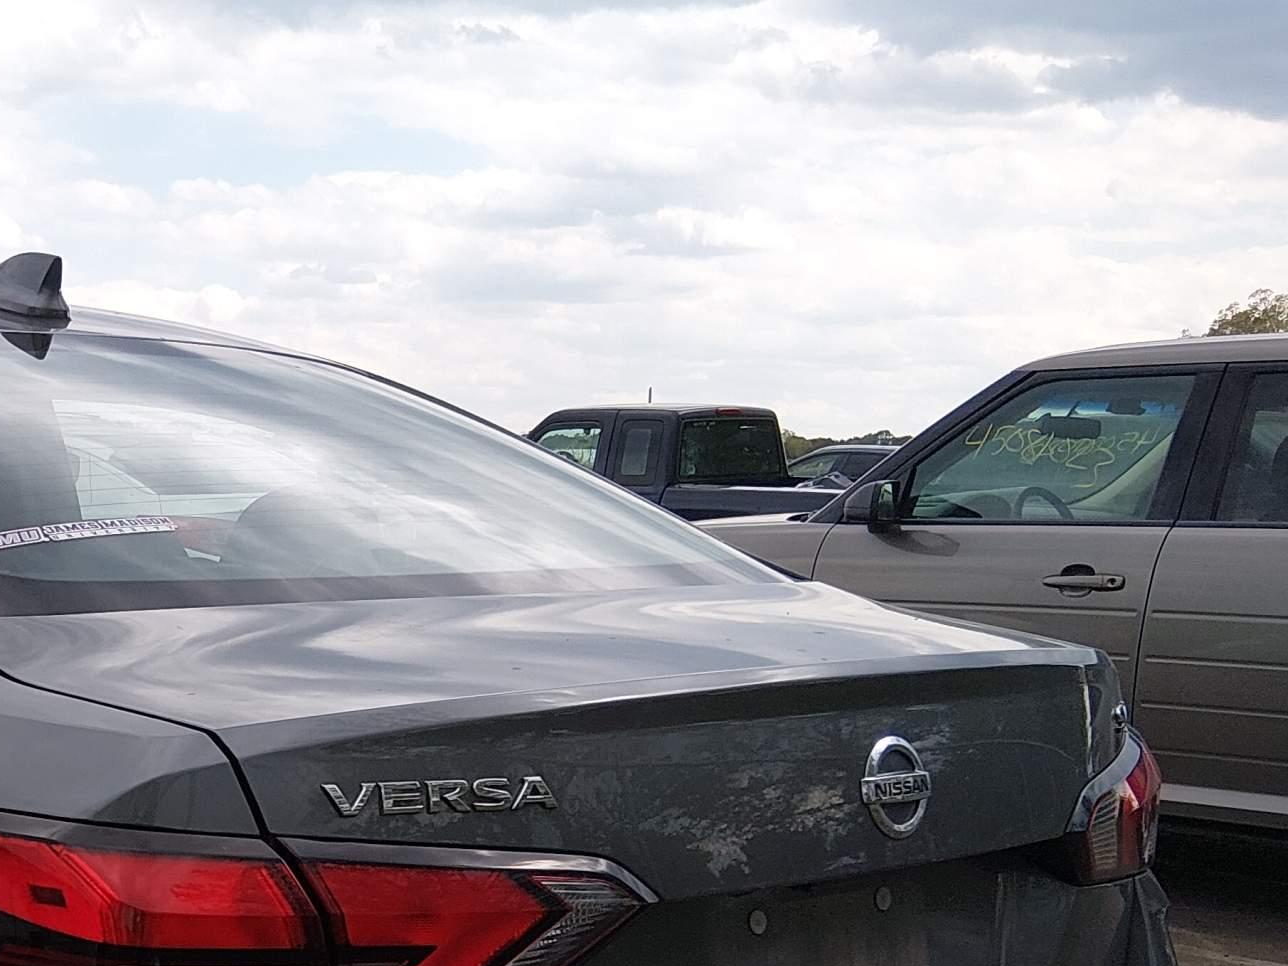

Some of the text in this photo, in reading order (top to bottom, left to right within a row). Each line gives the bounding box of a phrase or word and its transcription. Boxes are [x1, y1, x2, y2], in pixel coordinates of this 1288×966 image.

[46, 517, 171, 534] JAMES MADISON
[319, 774, 558, 818] VERSA
[874, 778, 929, 800] NISSAN
